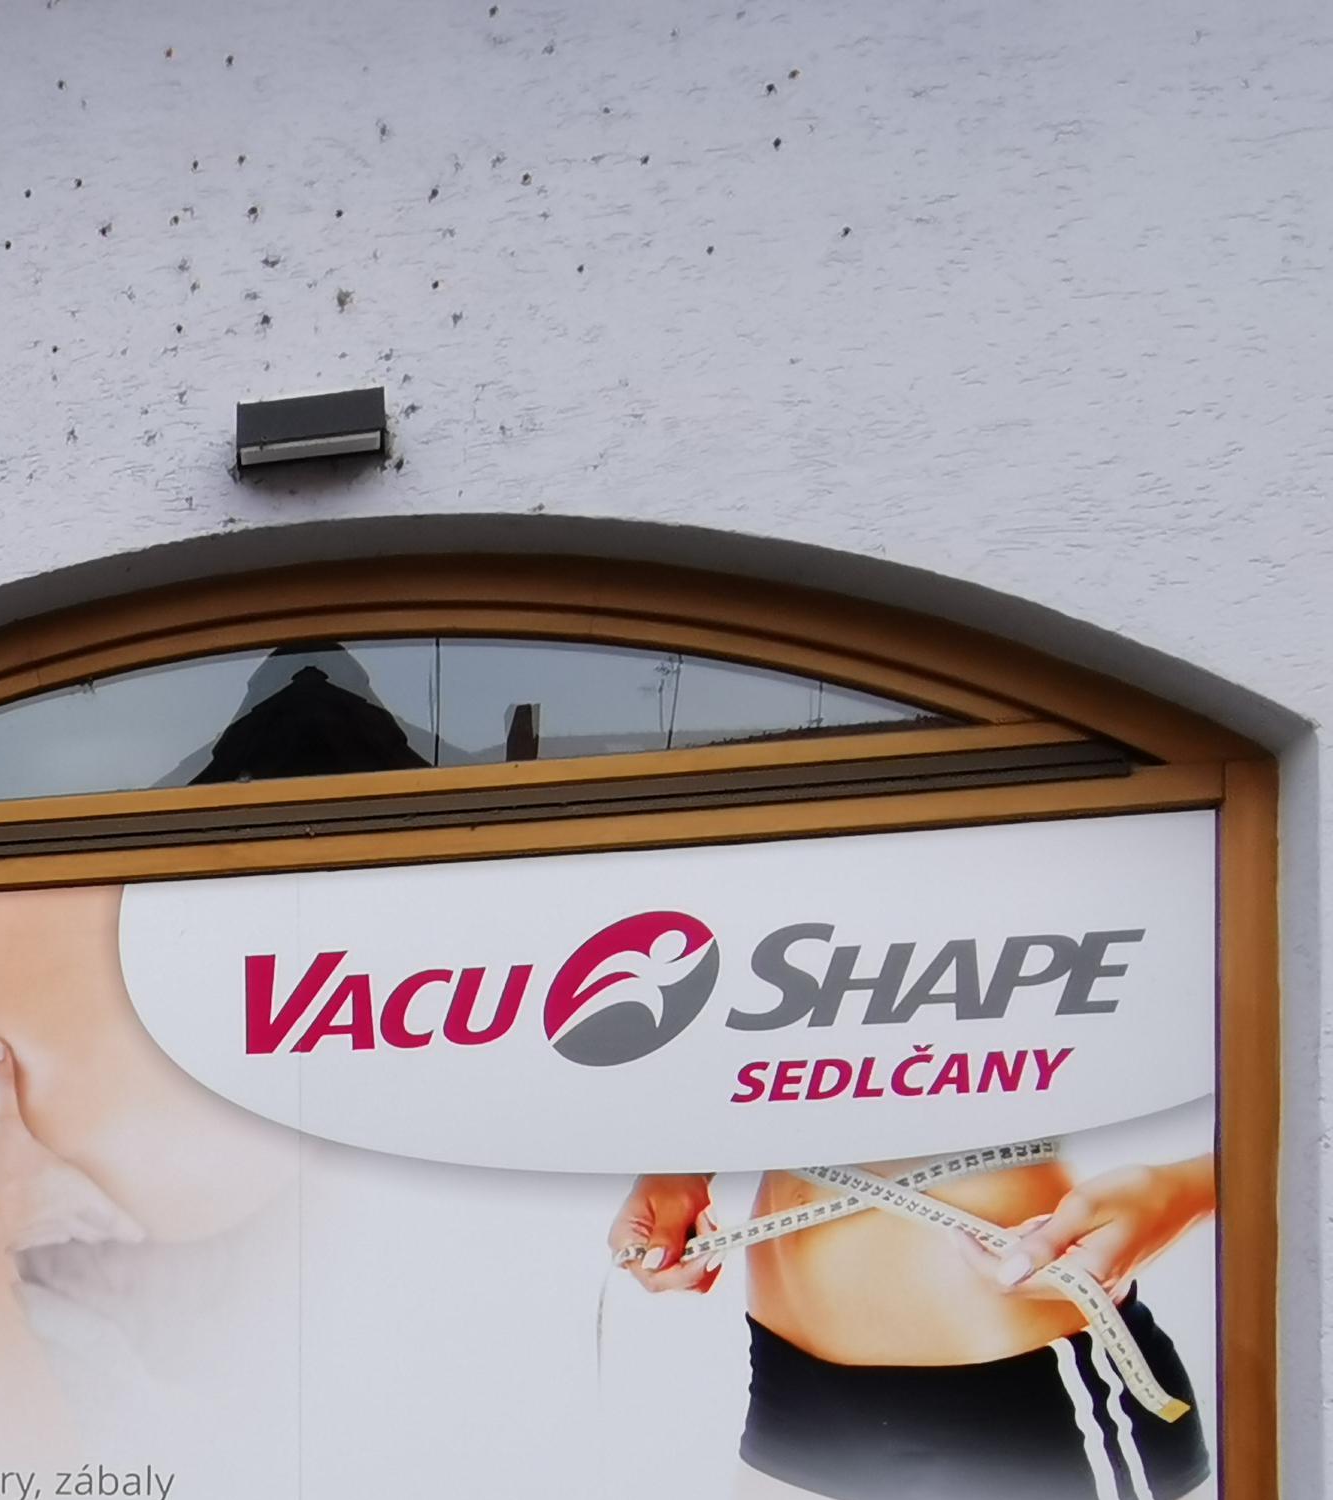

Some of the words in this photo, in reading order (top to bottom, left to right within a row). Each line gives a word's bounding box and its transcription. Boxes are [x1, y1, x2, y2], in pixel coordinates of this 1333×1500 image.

[244, 949, 534, 1056] VACU
[725, 923, 1145, 1032] SHAPE
[732, 1044, 1074, 1104] SEDLČANY
